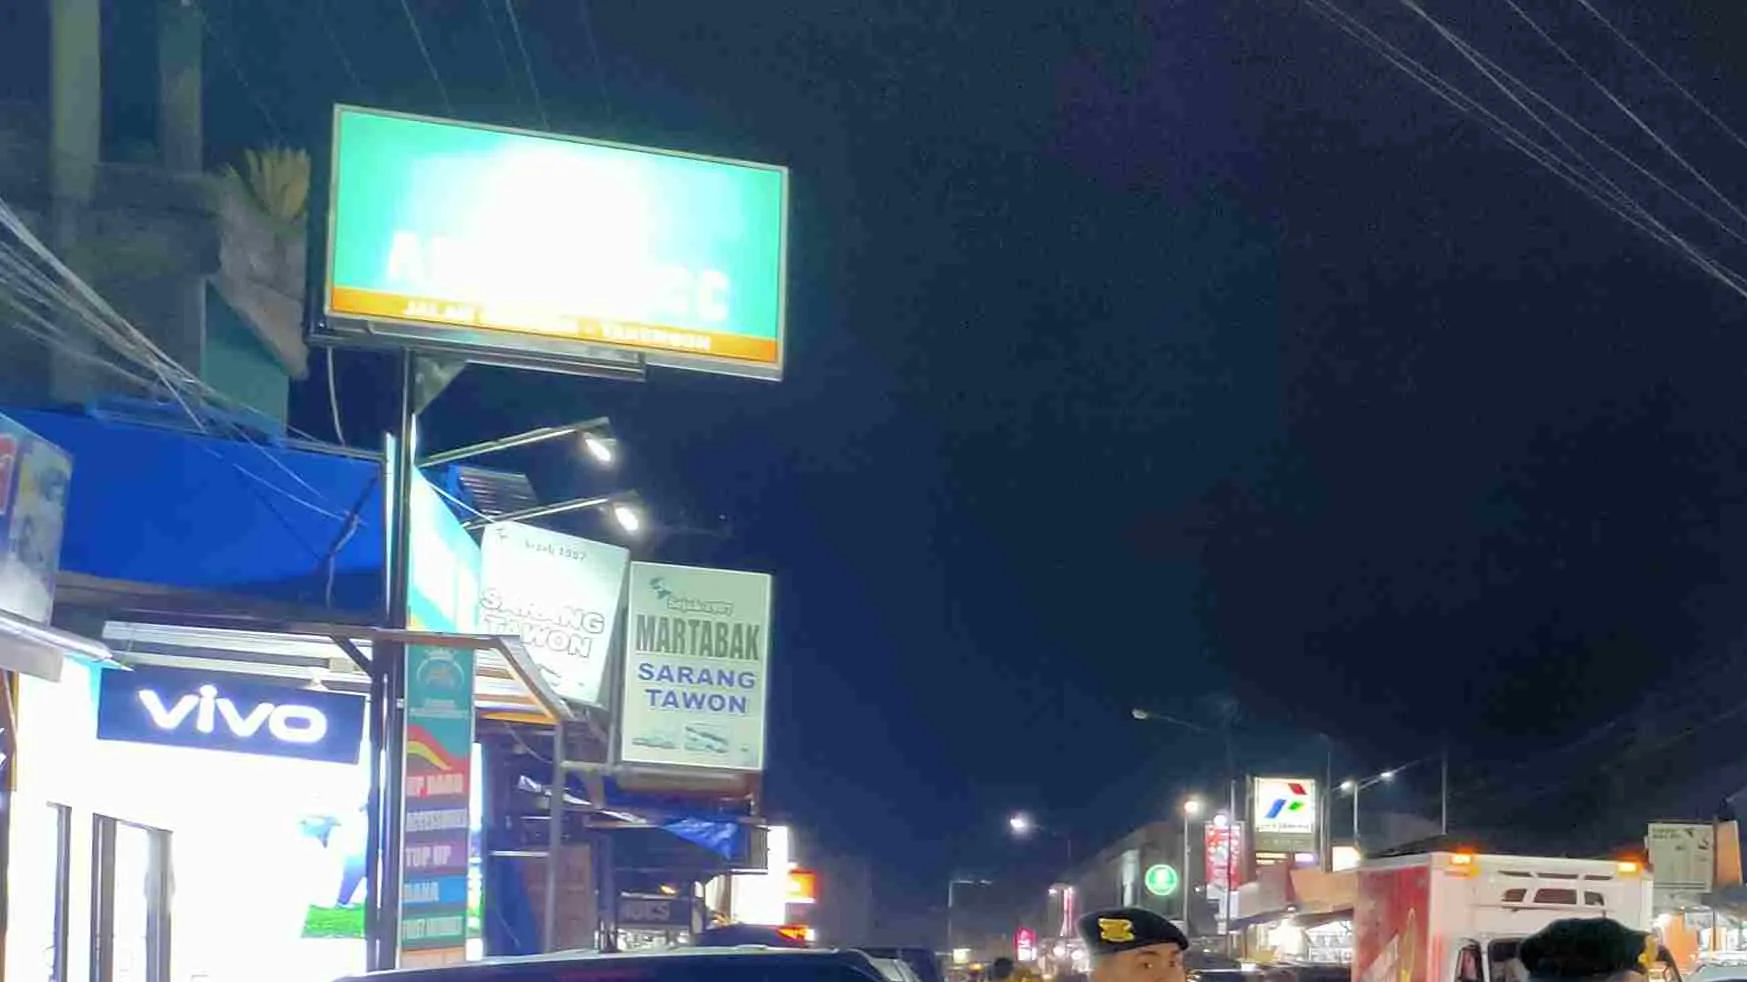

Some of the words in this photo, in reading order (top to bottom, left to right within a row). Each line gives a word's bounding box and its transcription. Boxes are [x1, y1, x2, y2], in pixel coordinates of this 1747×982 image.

[635, 614, 761, 661] MARTABAK
[637, 662, 756, 689] SARANG
[138, 684, 328, 743] vivo
[645, 688, 747, 714] TAWON
